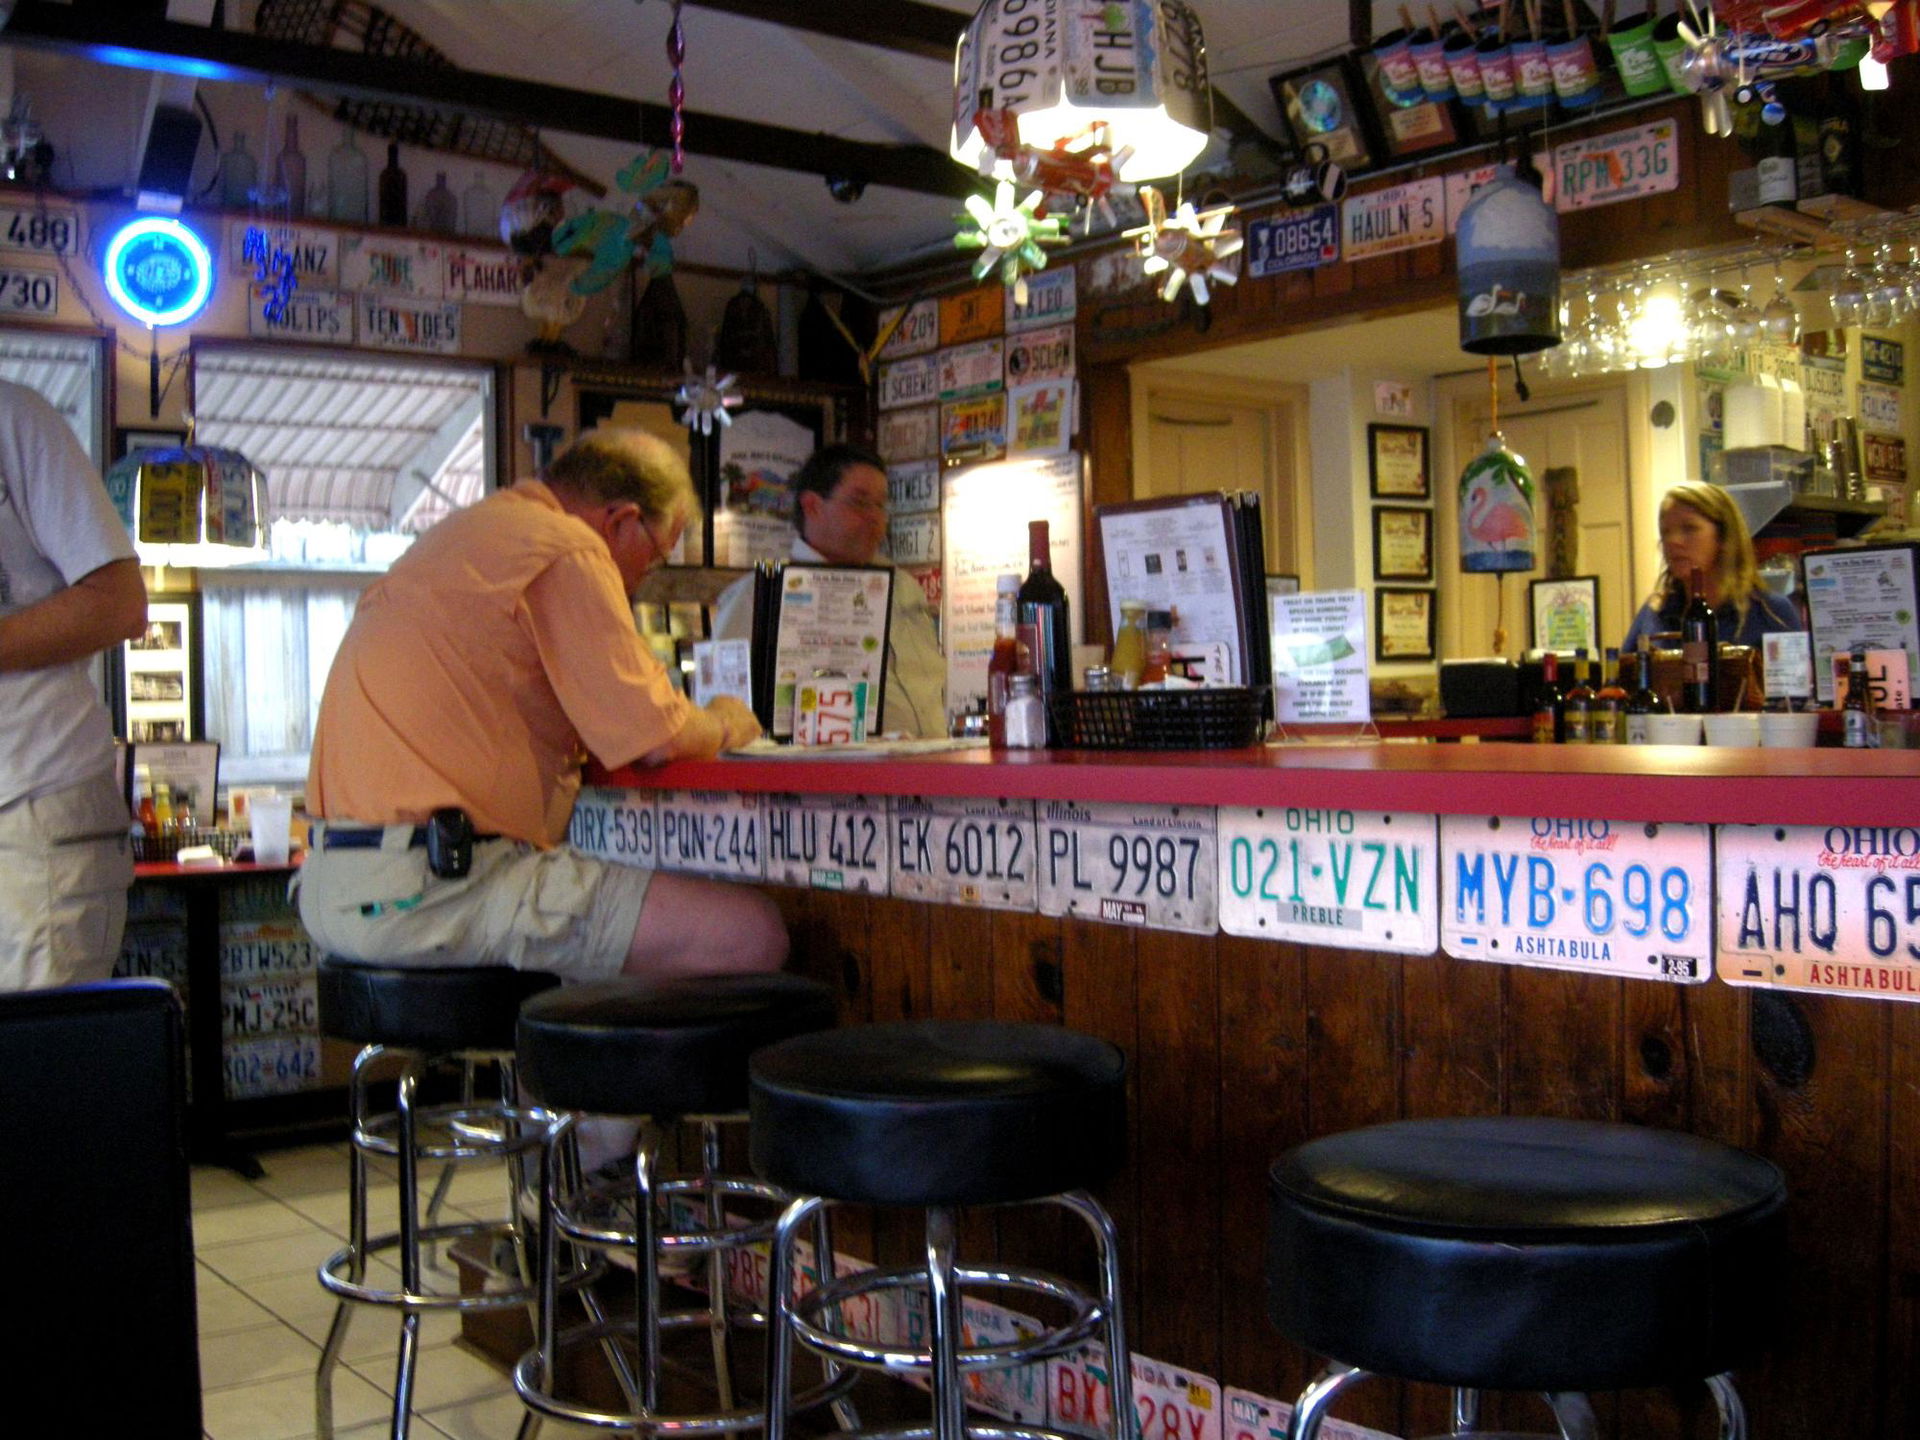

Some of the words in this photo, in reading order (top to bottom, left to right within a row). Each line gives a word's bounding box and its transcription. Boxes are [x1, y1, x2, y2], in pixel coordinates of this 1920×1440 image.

[1275, 216, 1333, 257] 08654
[1046, 803, 1092, 822] Illinois
[1285, 808, 1354, 835] OHIO
[769, 809, 817, 863] HLU
[828, 815, 877, 870] 412
[1531, 817, 1610, 840] OHIO
[1824, 826, 1920, 856] OHIO
[899, 819, 933, 876] EK
[945, 822, 1026, 883] 6012
[1049, 828, 1092, 891] PL
[1109, 834, 1201, 901] 9987
[1103, 900, 1122, 921] MAY
[1293, 905, 1343, 926] PREBLE
[1738, 867, 1838, 953] AHQ
[1515, 935, 1612, 961] ASHTABULA
[1810, 964, 1920, 993] ASHTABUL
